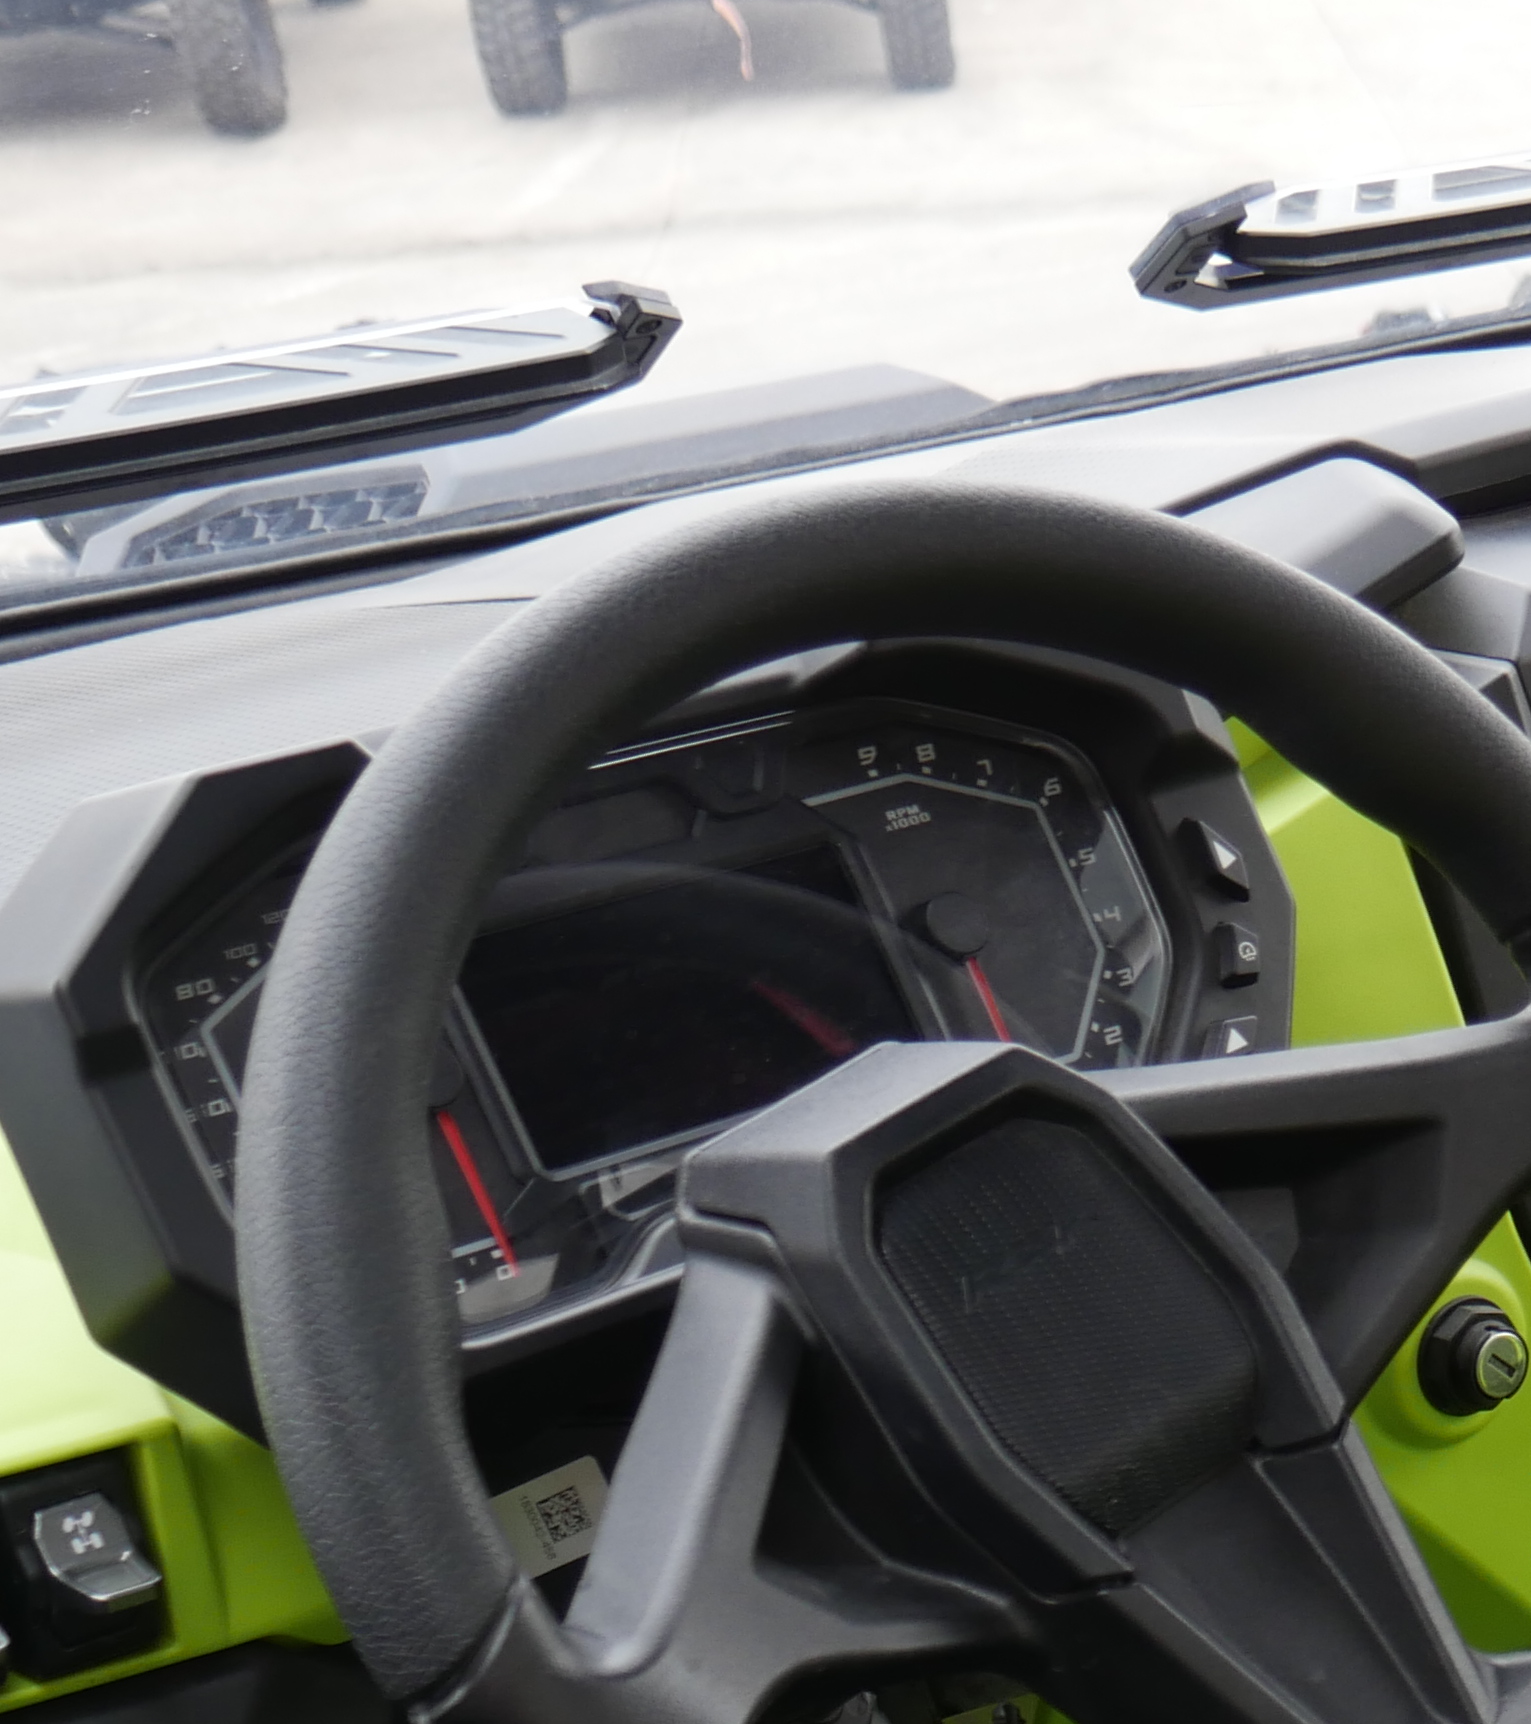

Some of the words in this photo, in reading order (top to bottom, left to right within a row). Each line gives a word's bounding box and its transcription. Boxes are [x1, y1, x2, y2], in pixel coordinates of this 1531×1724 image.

[858, 745, 877, 766] 9
[916, 743, 935, 762] 8
[1044, 777, 1062, 797] 6
[885, 804, 920, 821] RPM
[885, 811, 931, 832] x1000
[1079, 847, 1096, 866] 5
[1103, 906, 1121, 922] 4
[223, 943, 257, 960] 100
[1117, 968, 1134, 987] 3
[175, 978, 215, 1001] 80
[1103, 1025, 1123, 1046] 2
